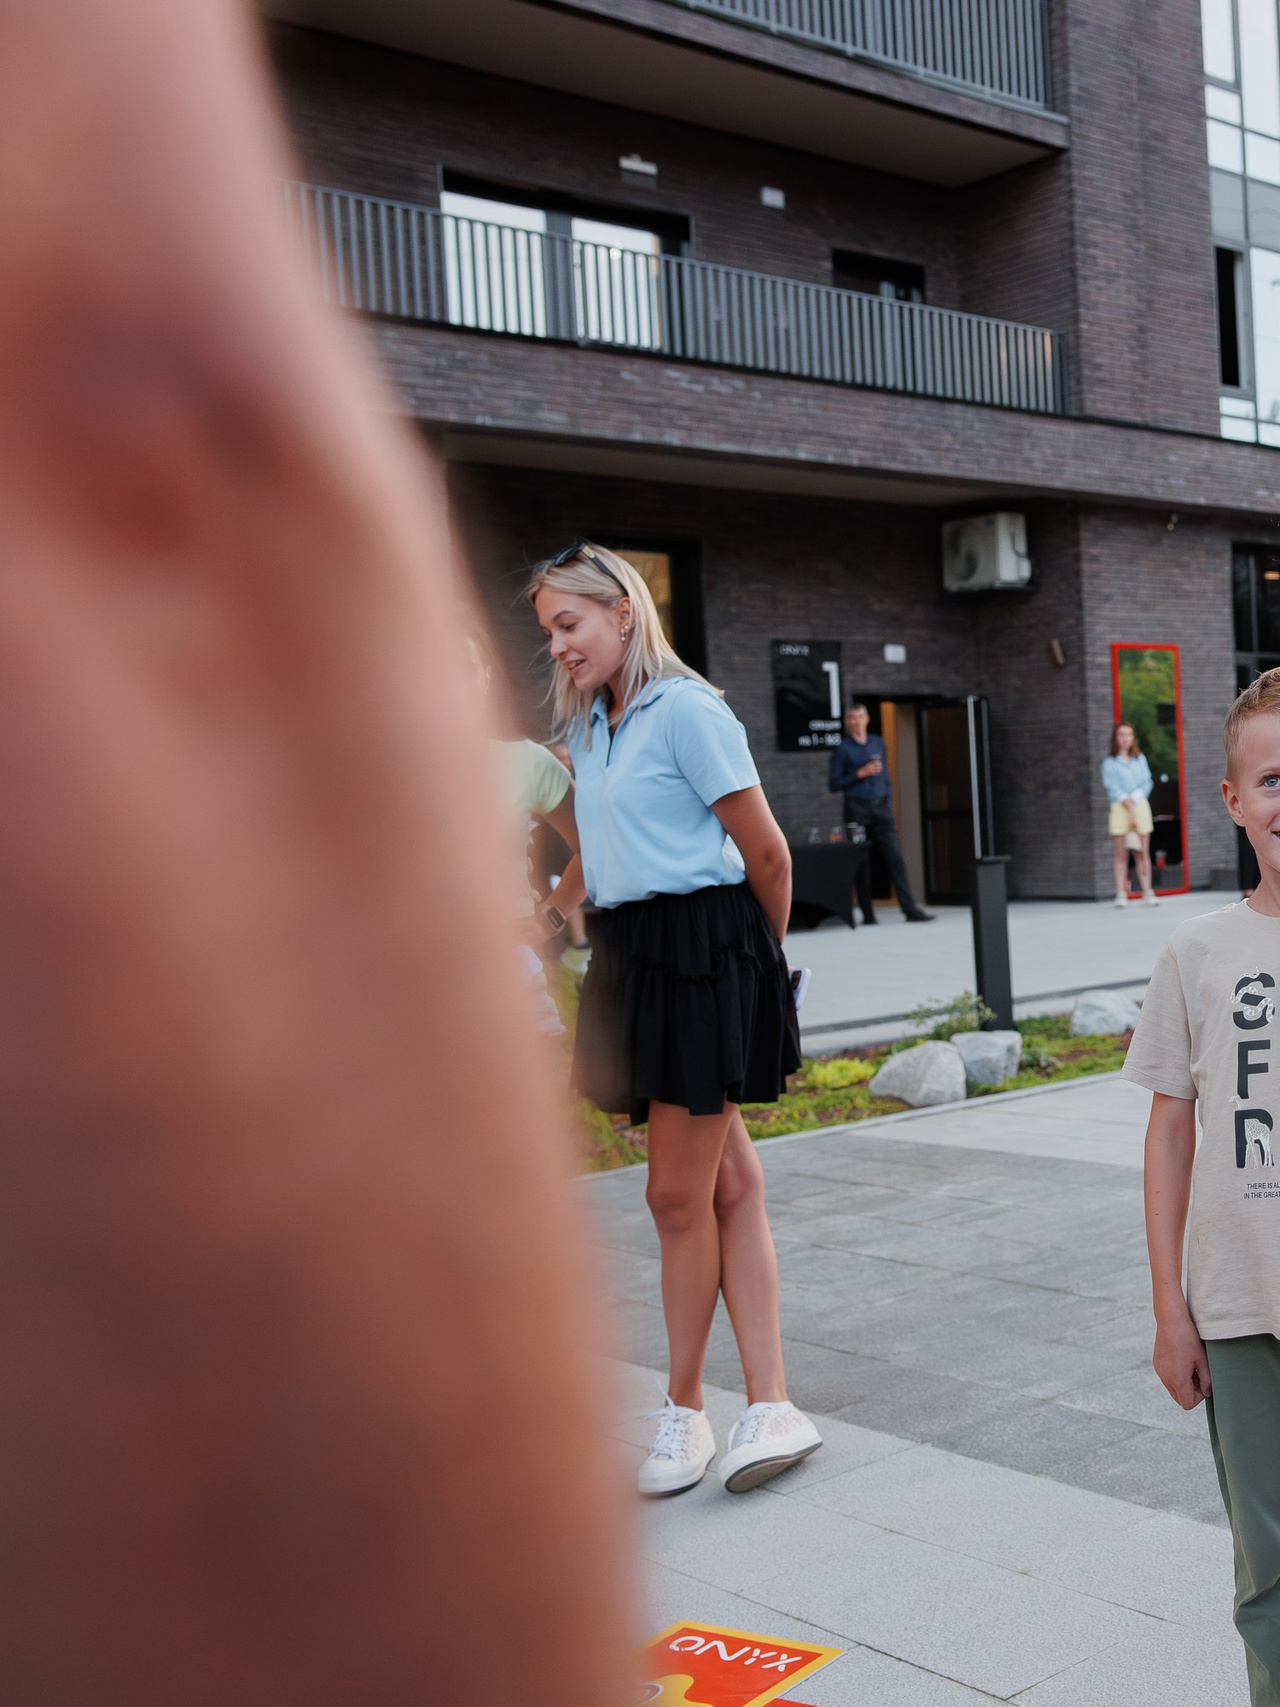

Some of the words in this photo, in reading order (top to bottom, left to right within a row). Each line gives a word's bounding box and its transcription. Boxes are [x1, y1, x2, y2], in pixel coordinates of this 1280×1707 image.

[821, 661, 841, 719] 1
[1243, 1192, 1250, 1200] IN
[1250, 1191, 1263, 1199] THE
[1246, 1182, 1266, 1190] THERE
[1267, 1181, 1273, 1189] IS
[669, 1636, 802, 1672] ONYX
